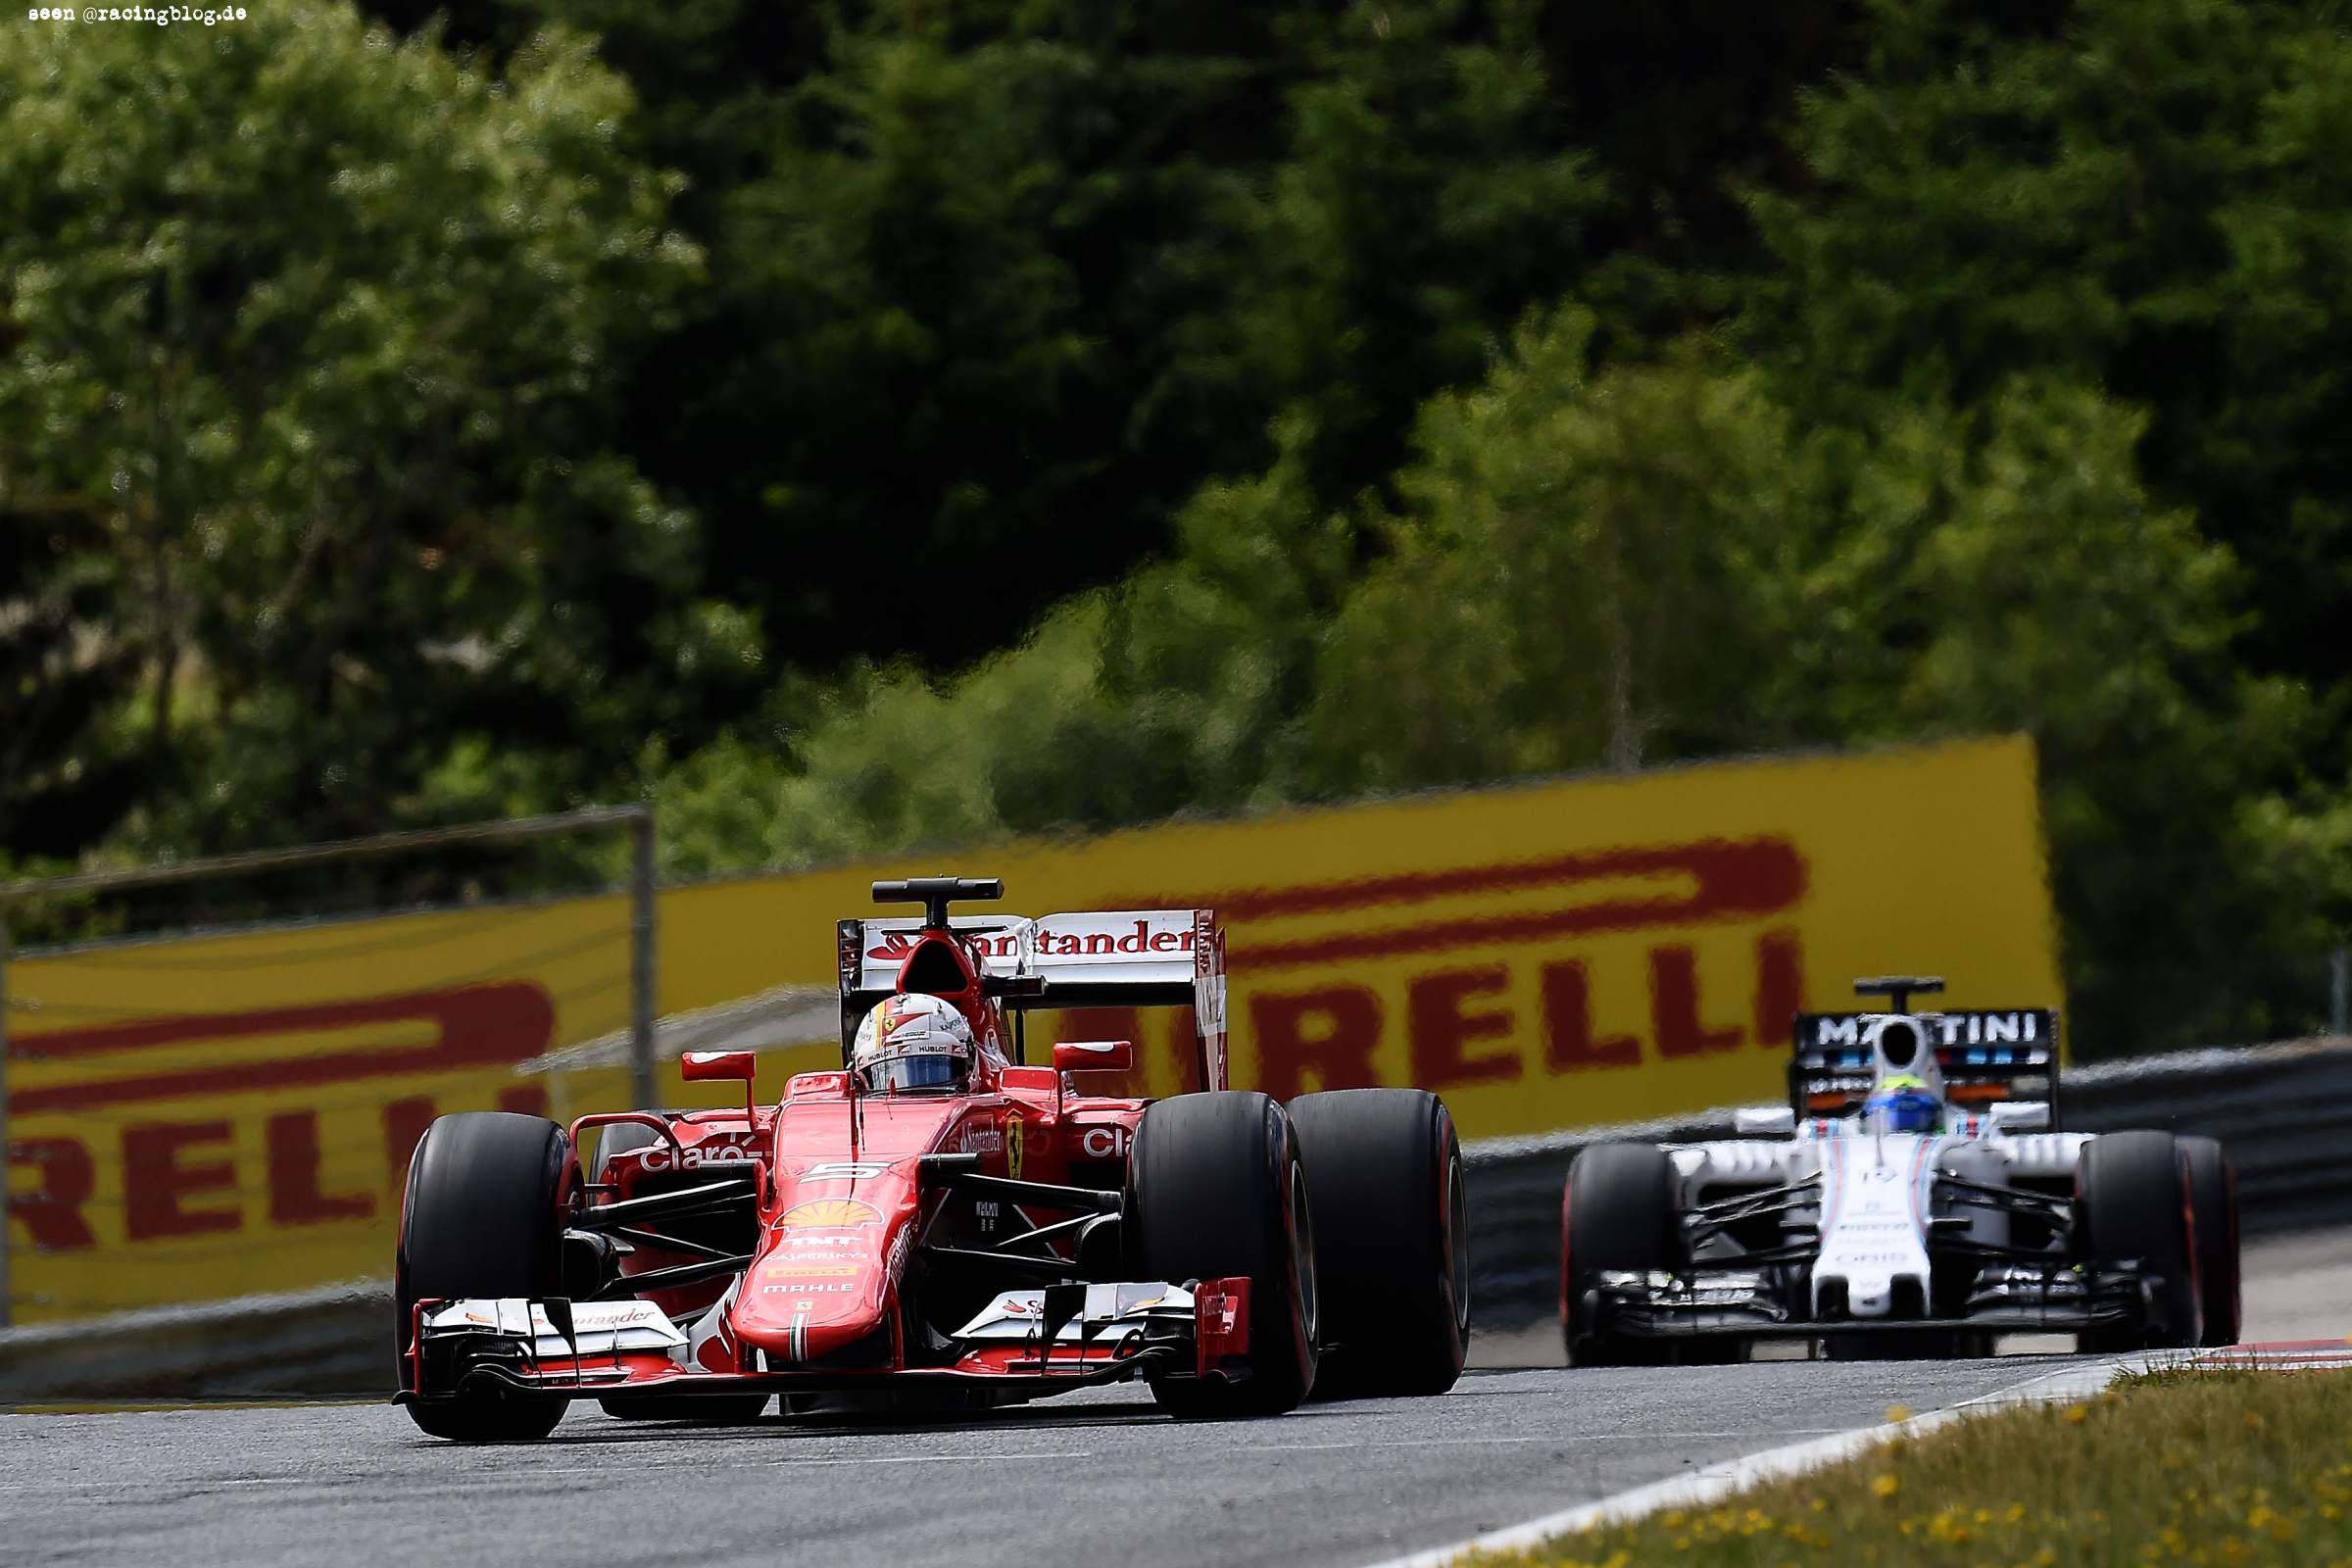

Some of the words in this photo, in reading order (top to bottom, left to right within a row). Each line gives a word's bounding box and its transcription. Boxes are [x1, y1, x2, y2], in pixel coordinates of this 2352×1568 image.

[970, 918, 1195, 957] antander
[1818, 1012, 2037, 1046] MTINI
[867, 1050, 893, 1062] HUBLOT
[762, 1284, 856, 1295] MAHLE
